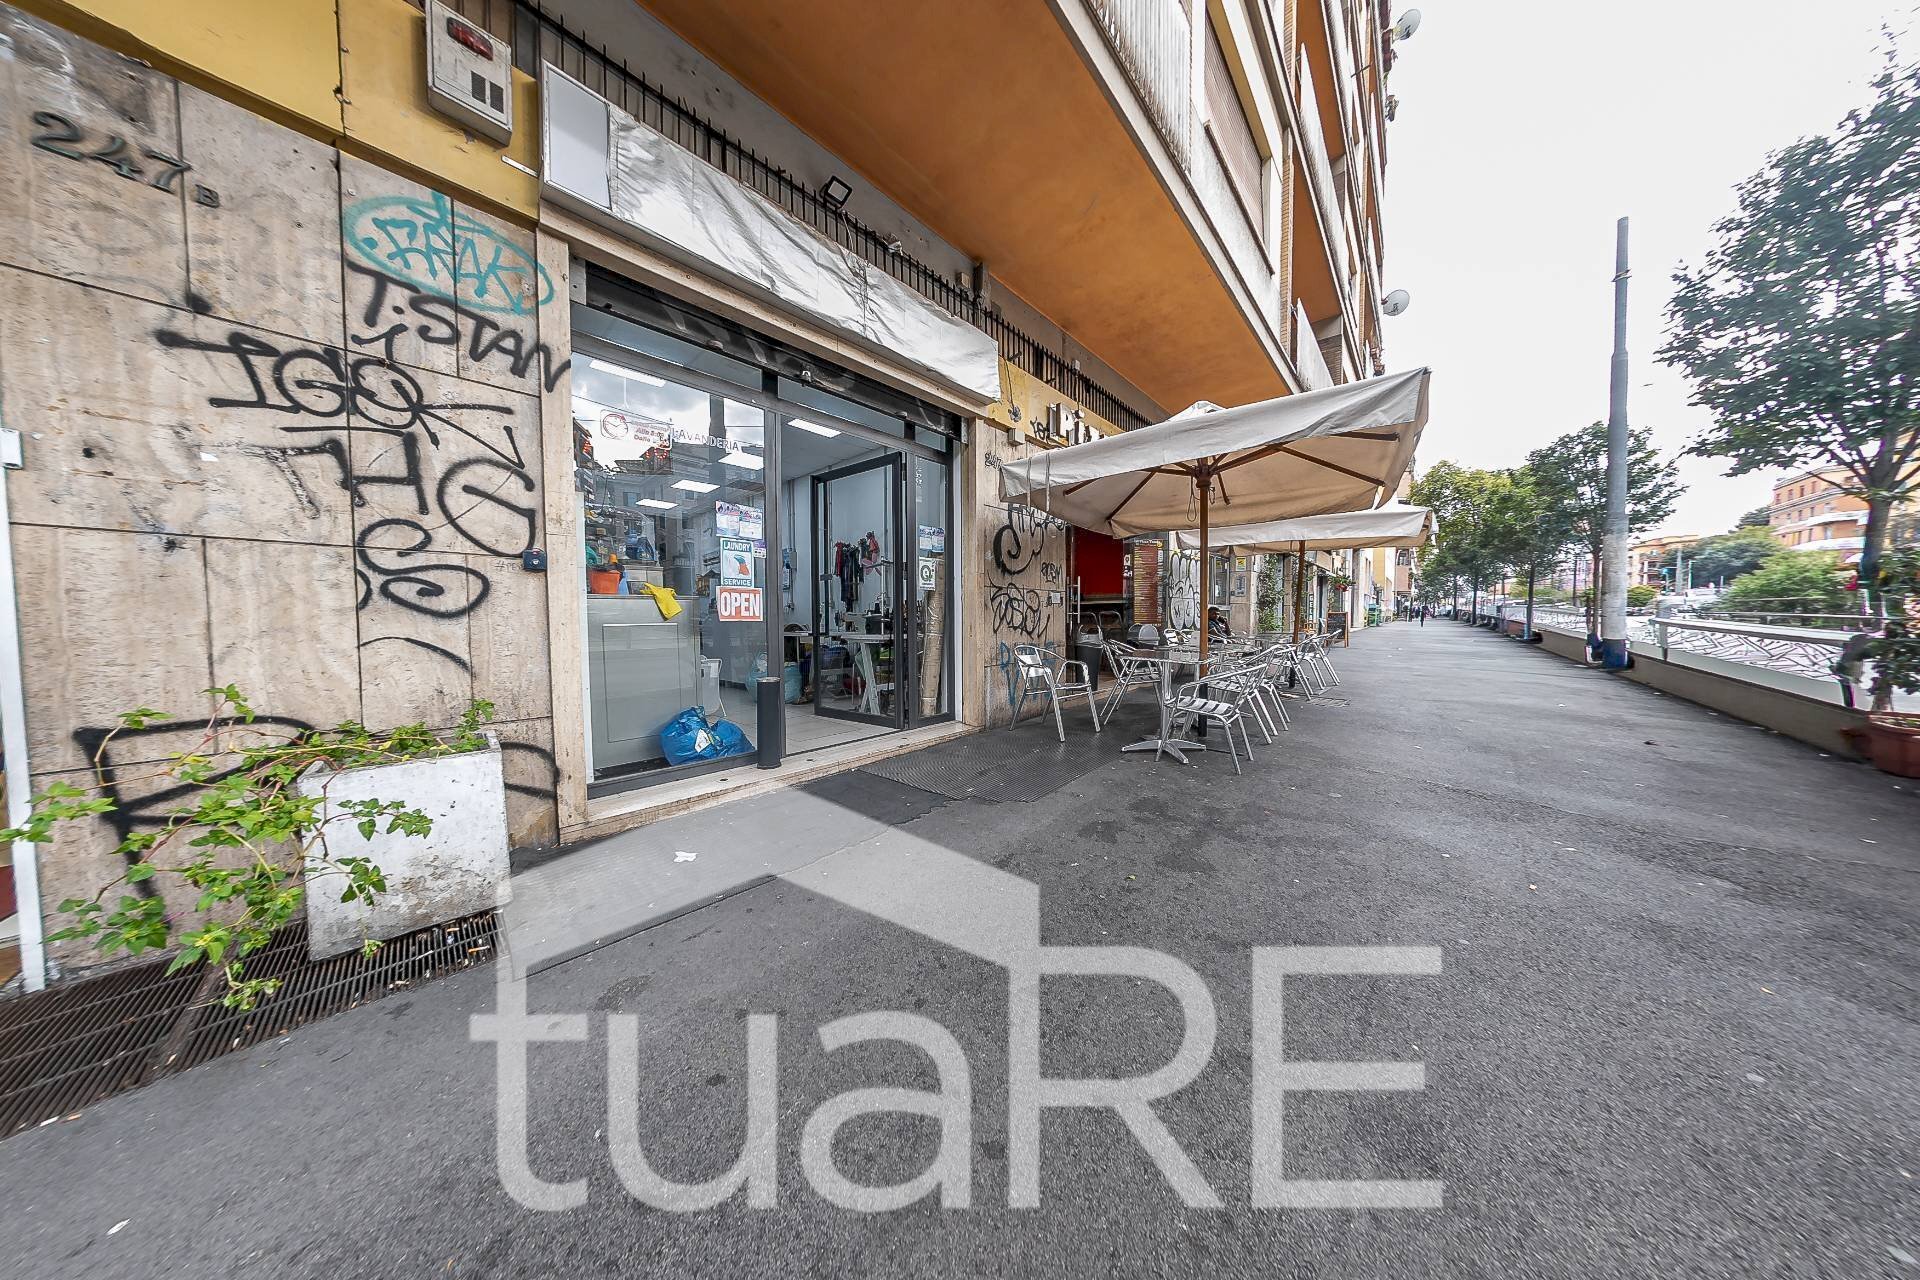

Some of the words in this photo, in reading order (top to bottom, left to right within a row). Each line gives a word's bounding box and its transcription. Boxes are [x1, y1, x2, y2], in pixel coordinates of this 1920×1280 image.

[31, 110, 193, 195] 247
[672, 427, 740, 452] LAVANDERIA
[723, 541, 752, 553] LAUNDRY
[723, 578, 752, 587] SERVICE
[720, 591, 761, 617] OPEN
